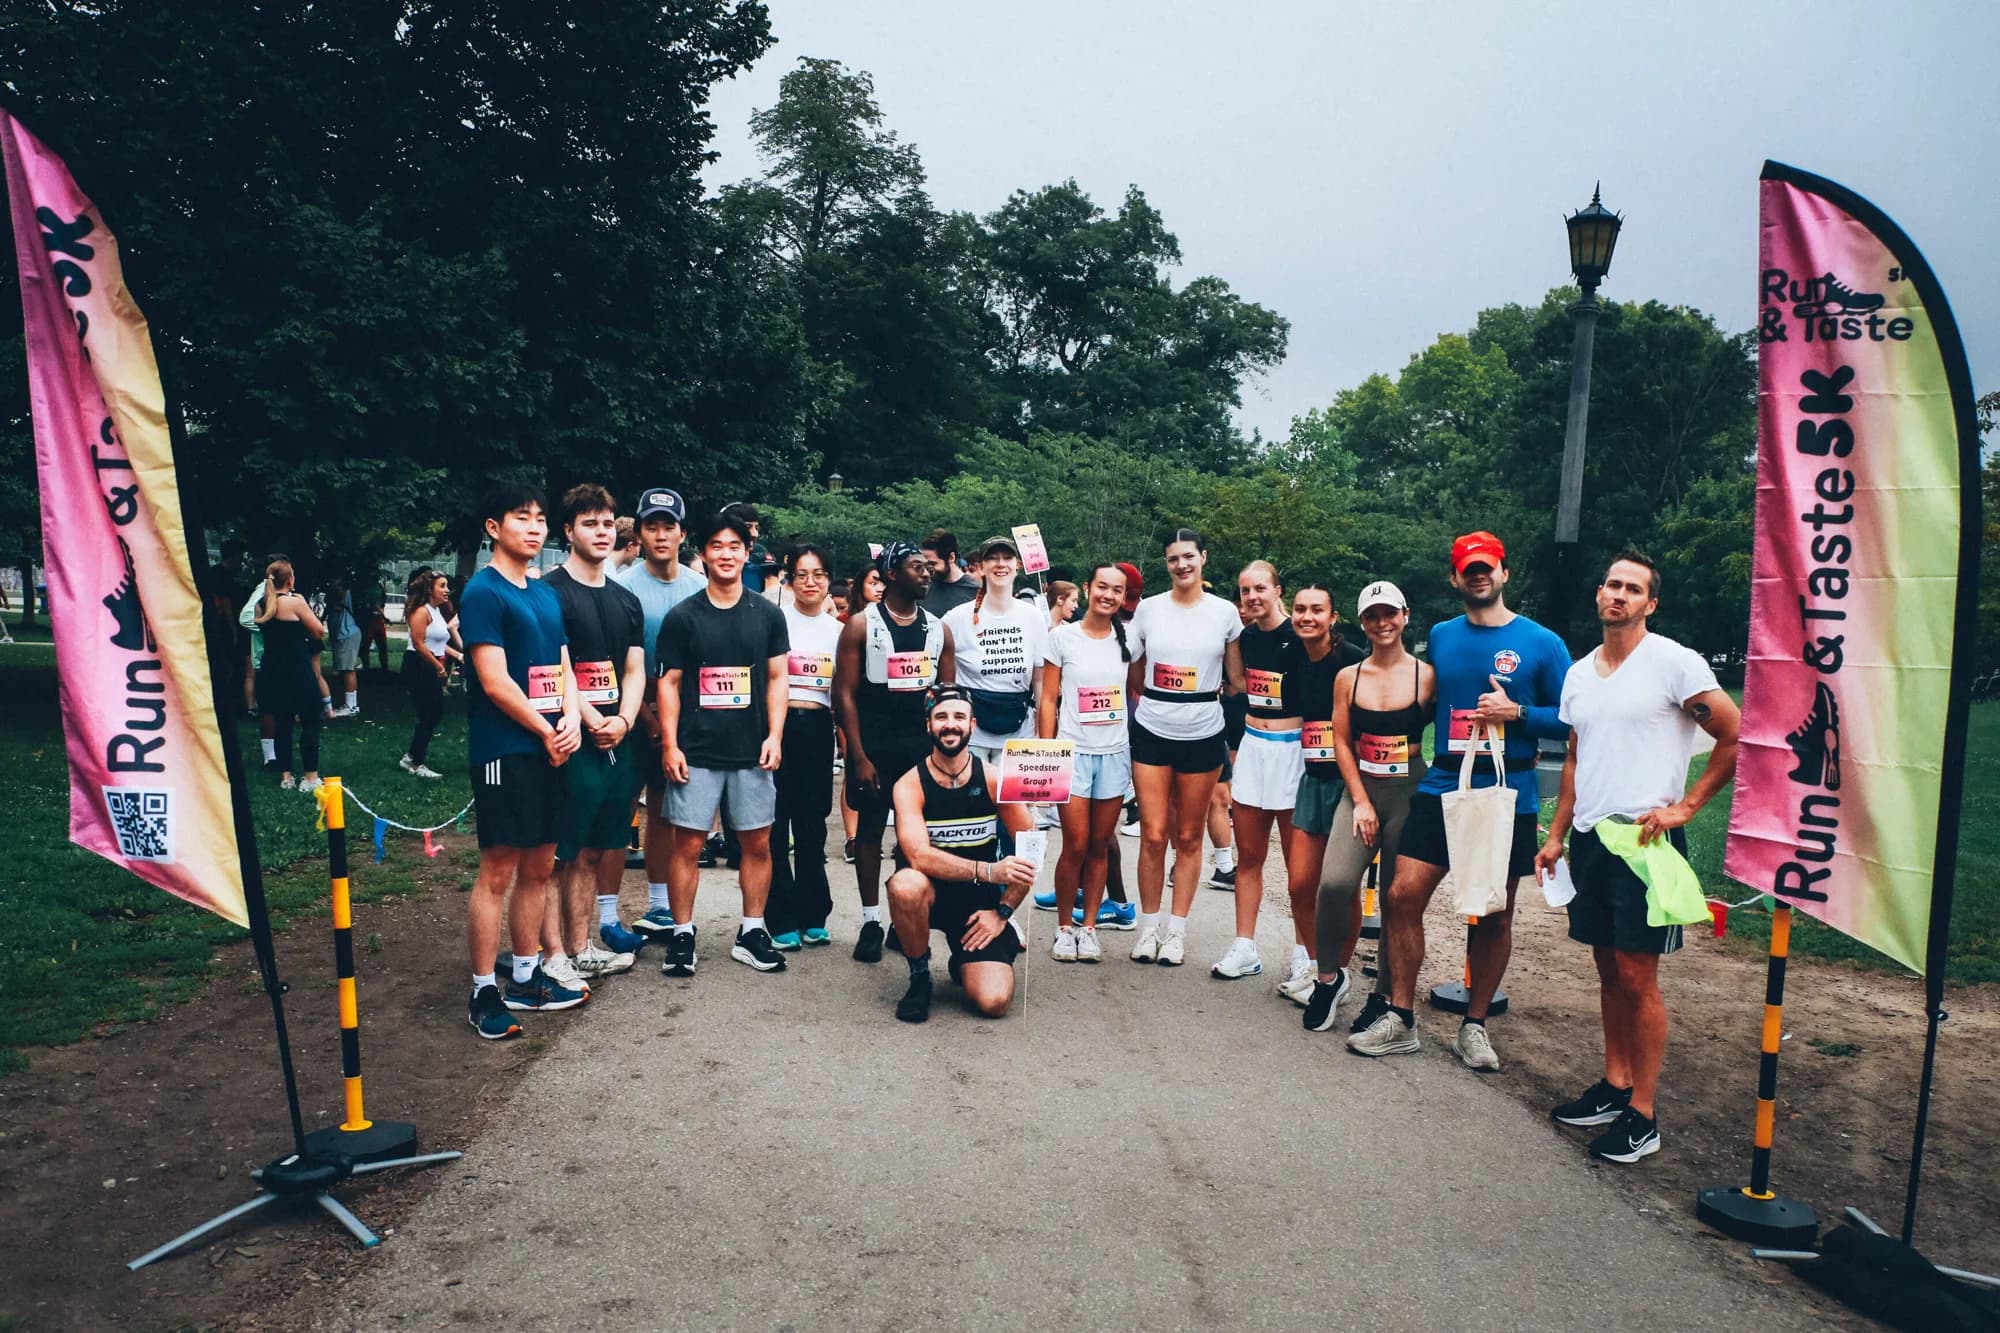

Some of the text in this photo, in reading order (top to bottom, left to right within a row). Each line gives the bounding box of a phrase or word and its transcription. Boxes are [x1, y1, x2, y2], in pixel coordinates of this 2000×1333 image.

[1762, 268, 1826, 305] Run
[1759, 307, 1914, 344] & Taste
[104, 484, 139, 527] &
[1774, 364, 1856, 903] Run & Taste 5K
[1009, 636, 1023, 644] let
[802, 663, 817, 673] 80
[900, 665, 921, 675] 104
[589, 676, 610, 687] 219
[716, 681, 734, 691] 111
[1163, 676, 1183, 687] 210
[542, 681, 557, 693] 112
[1251, 683, 1269, 693] 224
[1092, 699, 1111, 708] 212
[106, 660, 166, 774] Run
[1309, 735, 1321, 744] 211
[1060, 749, 1071, 757] 5K
[1374, 750, 1389, 760] 37
[1019, 763, 1060, 772] Speedster
[1023, 778, 1047, 786] Group
[928, 826, 987, 838] LACKTOE
